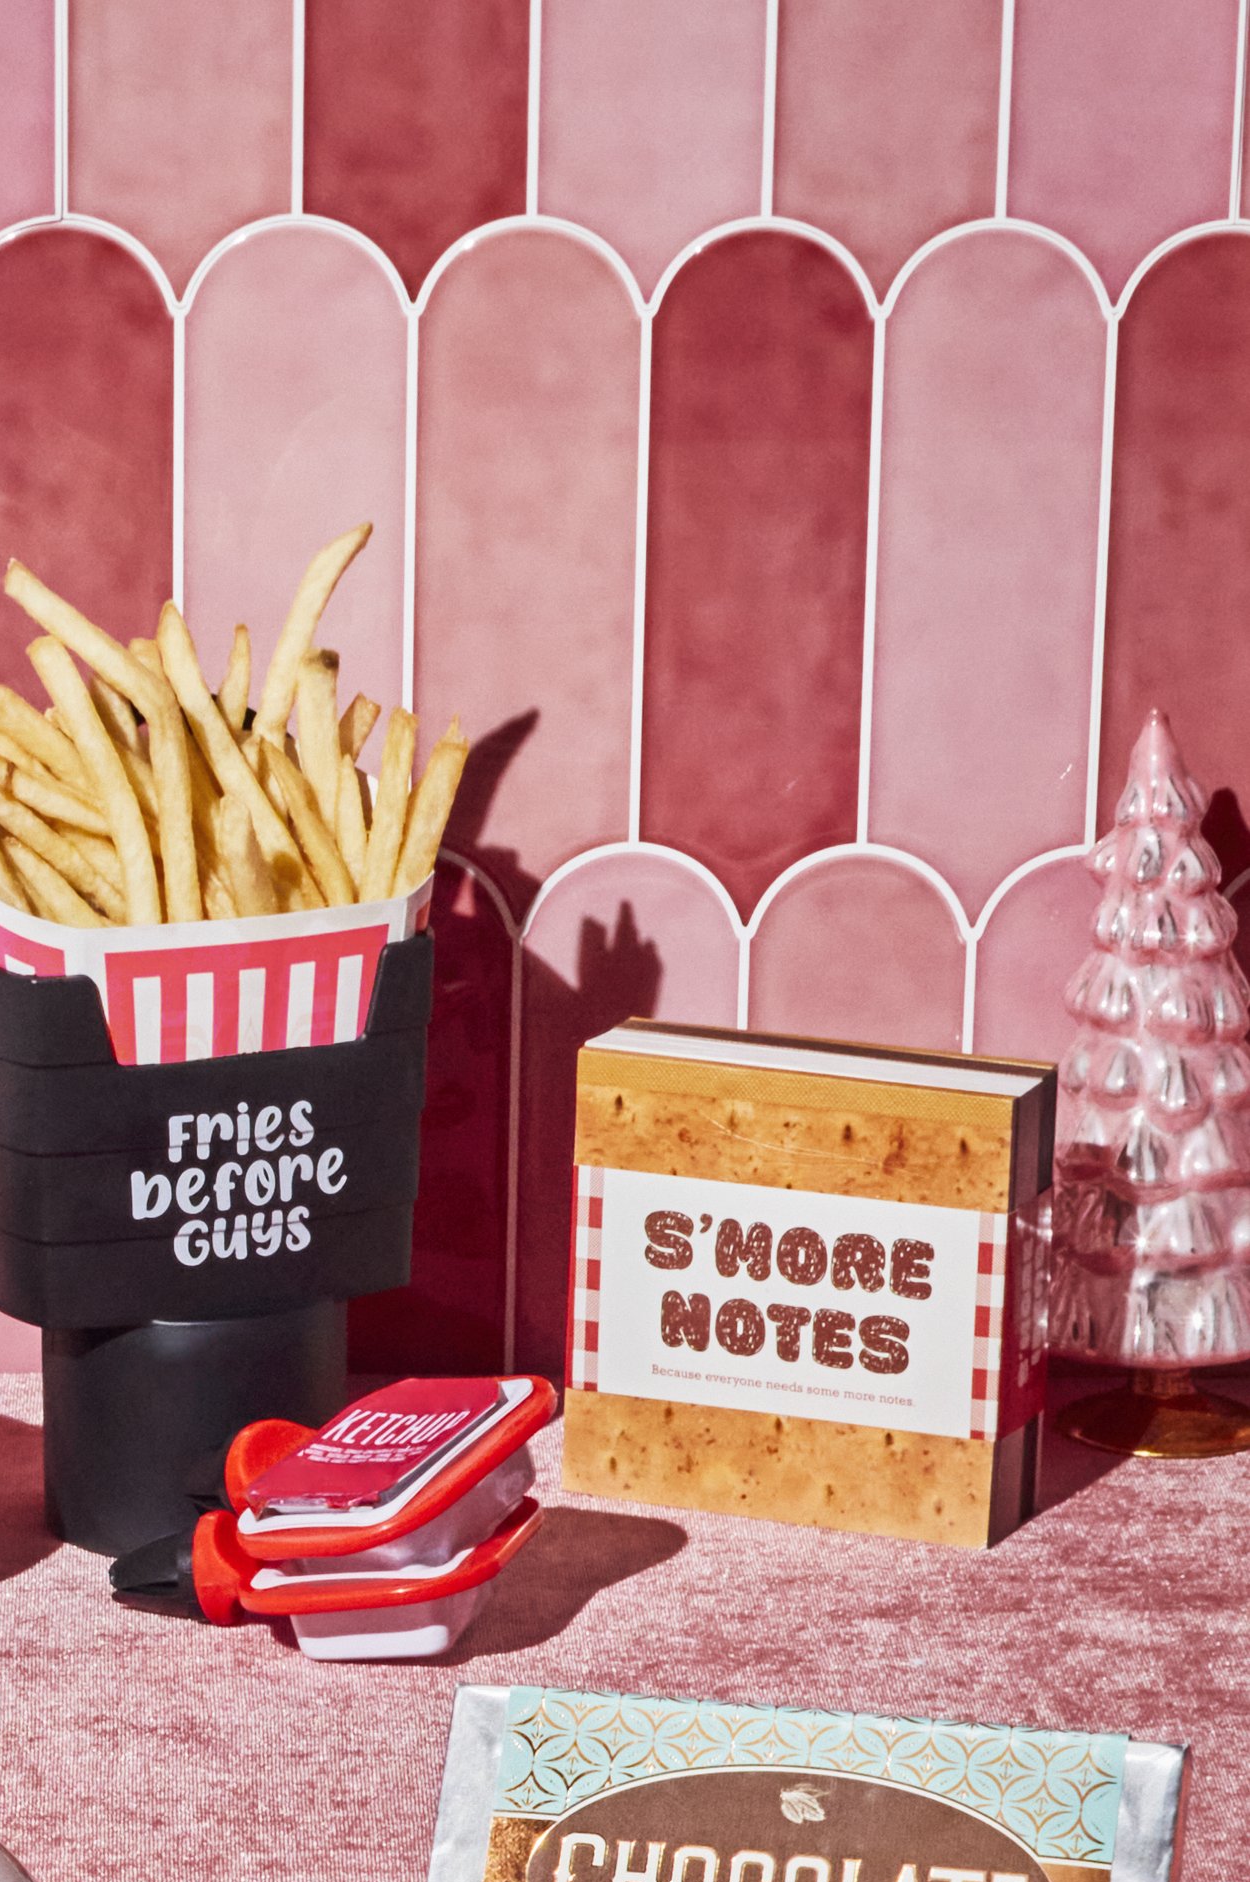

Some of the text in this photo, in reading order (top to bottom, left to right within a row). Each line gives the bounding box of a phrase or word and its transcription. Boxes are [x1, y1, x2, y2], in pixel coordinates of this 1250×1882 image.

[168, 1100, 315, 1163] Fries
[130, 1147, 348, 1221] before
[173, 1206, 312, 1267] Guys
[644, 1210, 935, 1301] S'MORE
[660, 1289, 910, 1375] NOTES
[651, 1364, 916, 1407] Because everyone needs some more notes.
[321, 1409, 471, 1446] KETCHUP
